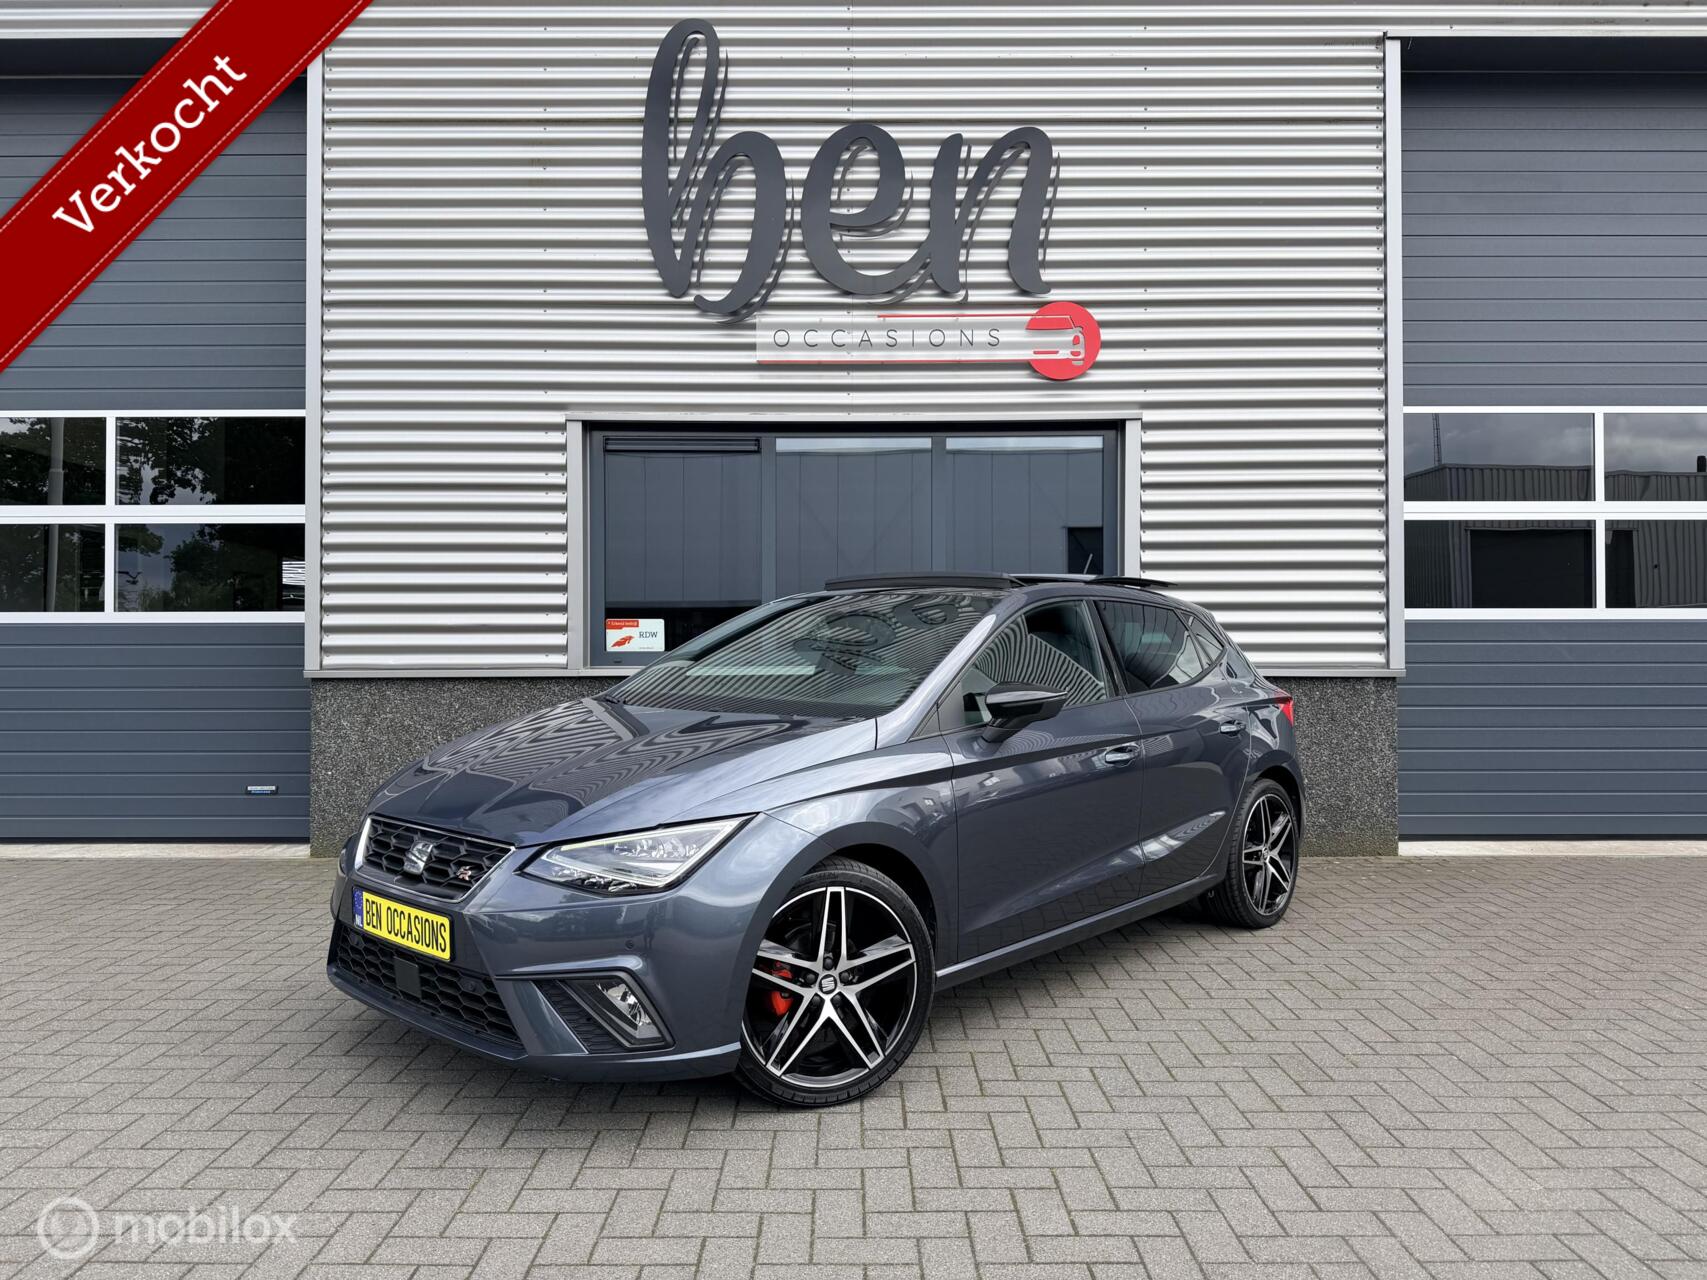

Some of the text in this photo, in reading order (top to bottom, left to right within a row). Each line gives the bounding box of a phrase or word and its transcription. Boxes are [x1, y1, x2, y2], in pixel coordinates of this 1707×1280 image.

[641, 18, 1052, 314] ben
[773, 328, 1000, 348] OCCASIONS
[639, 631, 658, 639] RDW
[365, 898, 446, 953] BEN OCCASIONS
